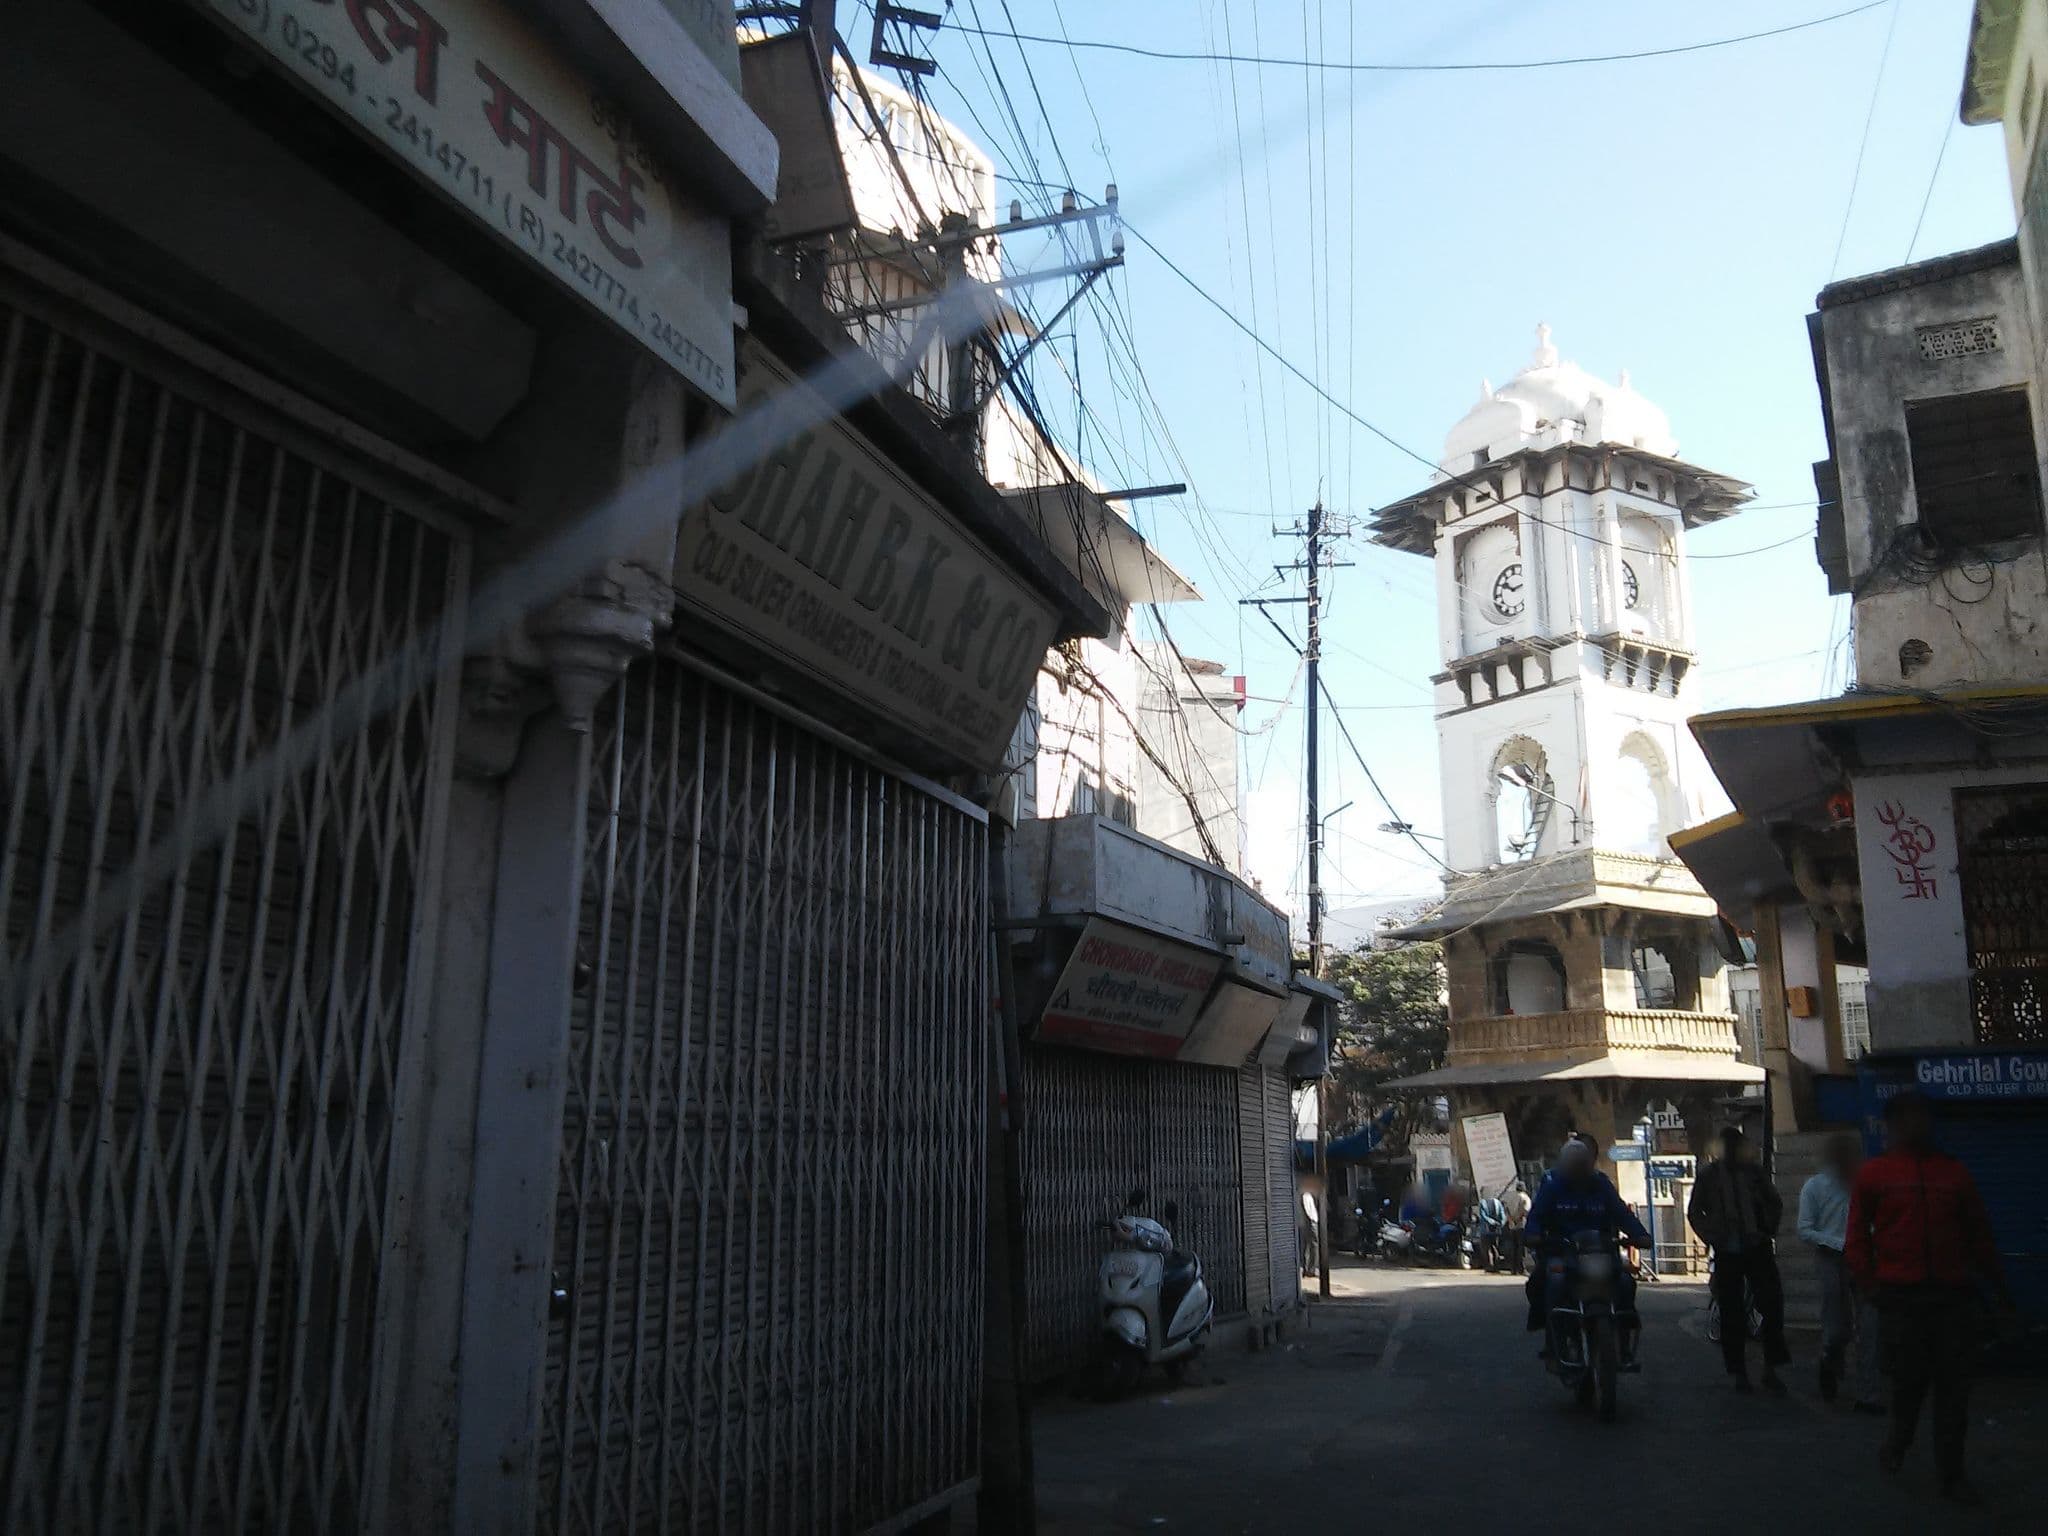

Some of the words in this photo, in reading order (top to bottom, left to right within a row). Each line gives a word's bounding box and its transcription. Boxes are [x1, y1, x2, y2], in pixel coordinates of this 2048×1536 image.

[282, 14, 355, 96] 0294
[1917, 1057, 2000, 1083] Gehrilal
[1946, 1083, 1972, 1096] OLD
[1976, 1082, 2019, 1095] SILVER
